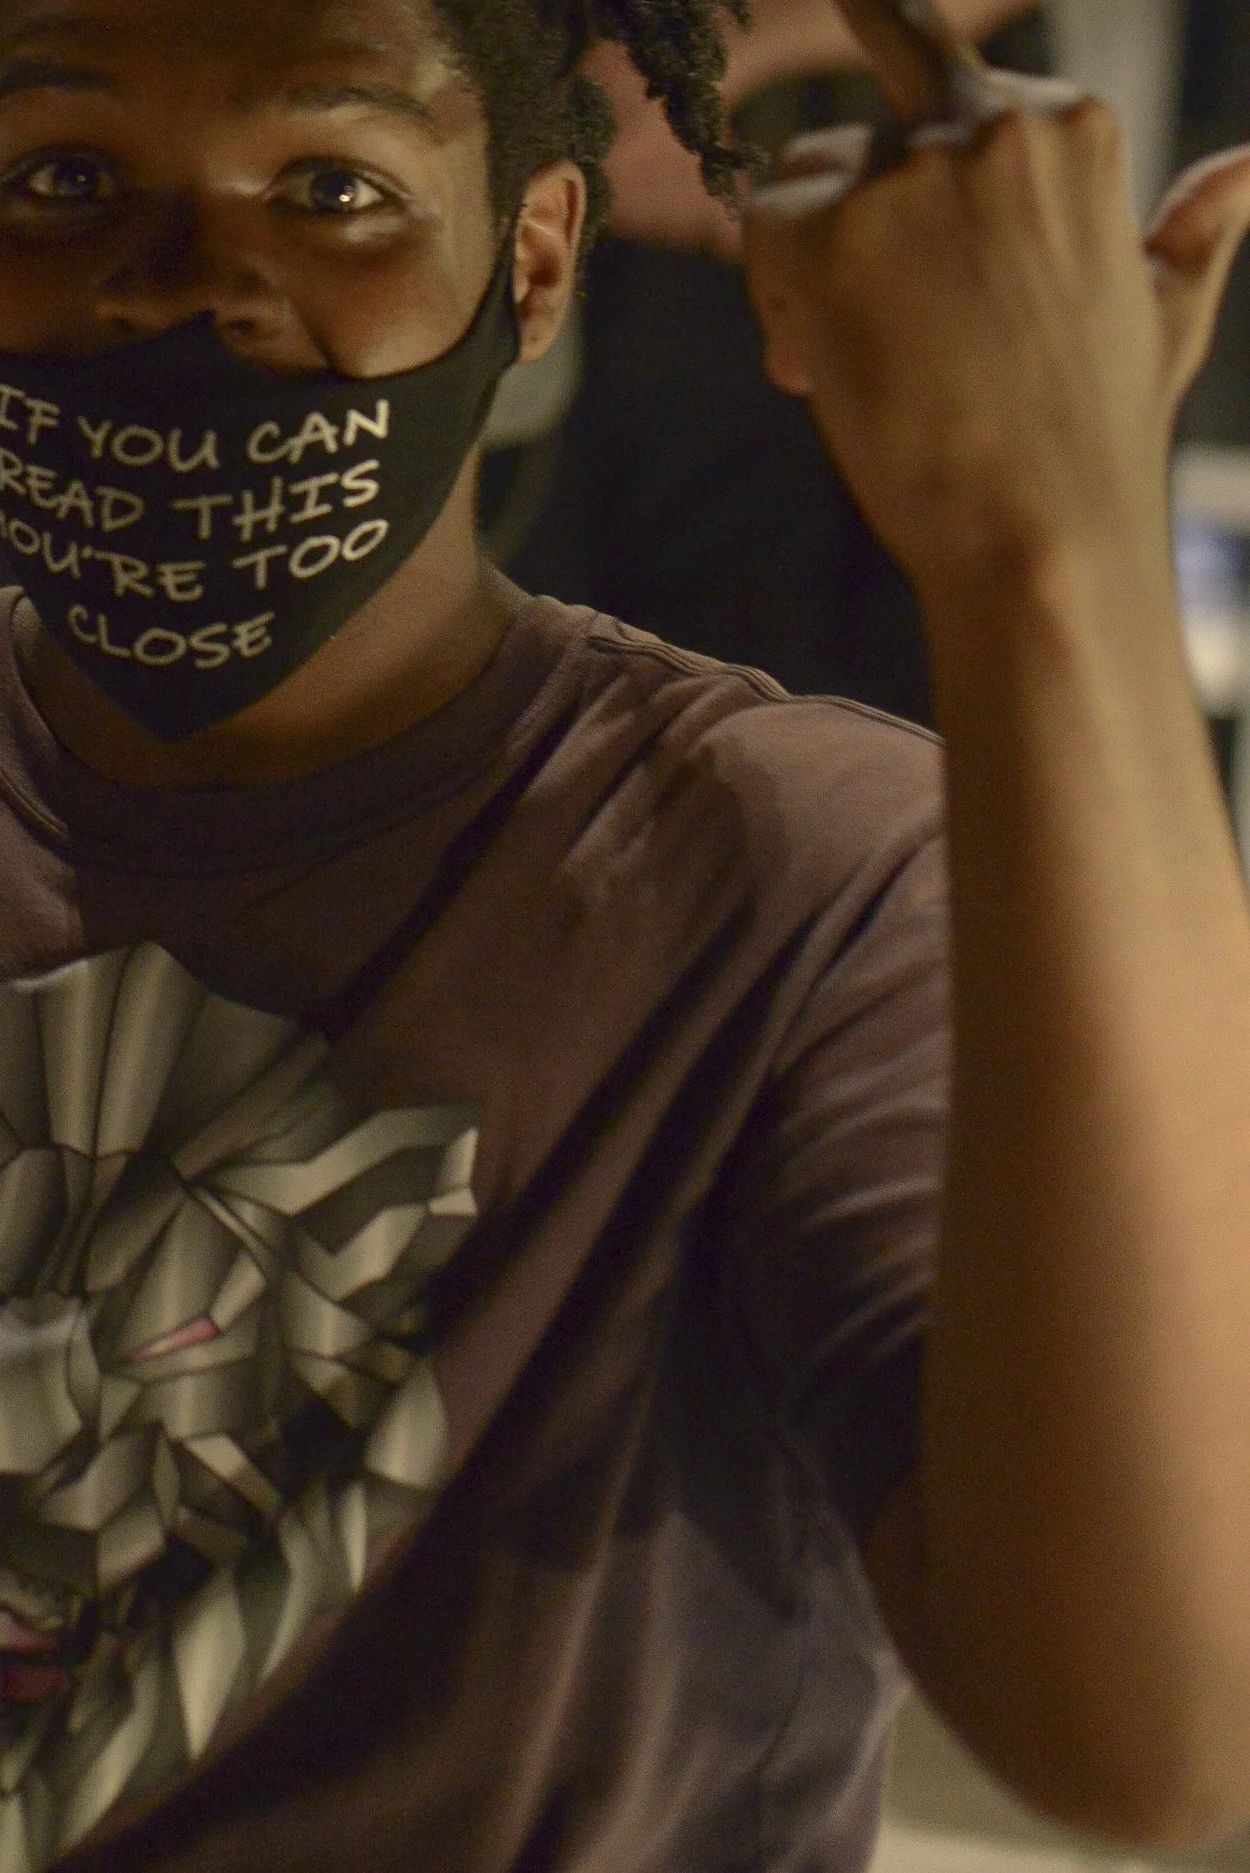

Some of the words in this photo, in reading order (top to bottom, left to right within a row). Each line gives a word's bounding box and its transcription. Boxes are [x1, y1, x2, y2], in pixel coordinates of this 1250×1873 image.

[77, 415, 220, 473] YOU
[247, 399, 390, 465] CAN
[173, 459, 381, 542] THIS
[232, 518, 390, 590] TOO
[67, 605, 276, 670] CLOSE
